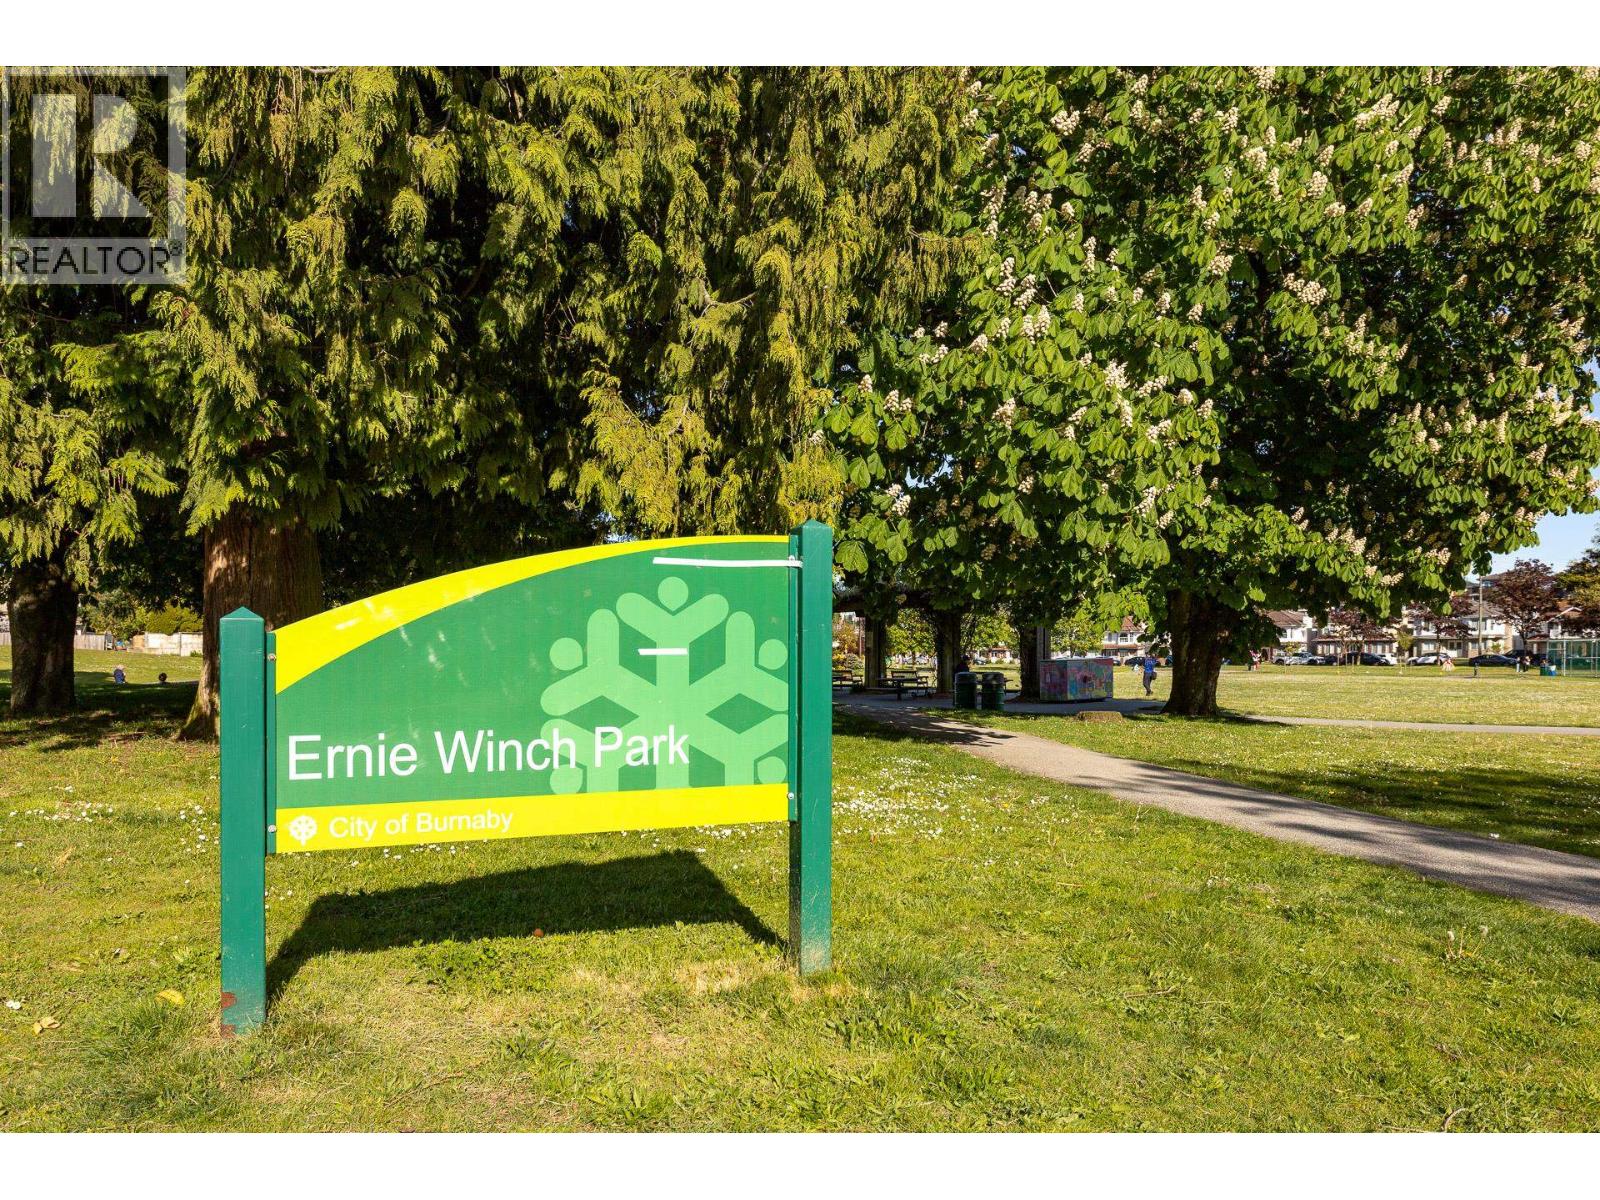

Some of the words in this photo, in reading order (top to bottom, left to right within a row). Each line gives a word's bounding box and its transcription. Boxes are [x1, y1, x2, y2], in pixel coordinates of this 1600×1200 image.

[288, 733, 418, 780] Ernie
[434, 727, 577, 775] Winch
[594, 725, 690, 768] Park
[328, 815, 376, 841] City
[385, 813, 409, 834] of
[416, 809, 514, 833] Burnaby
